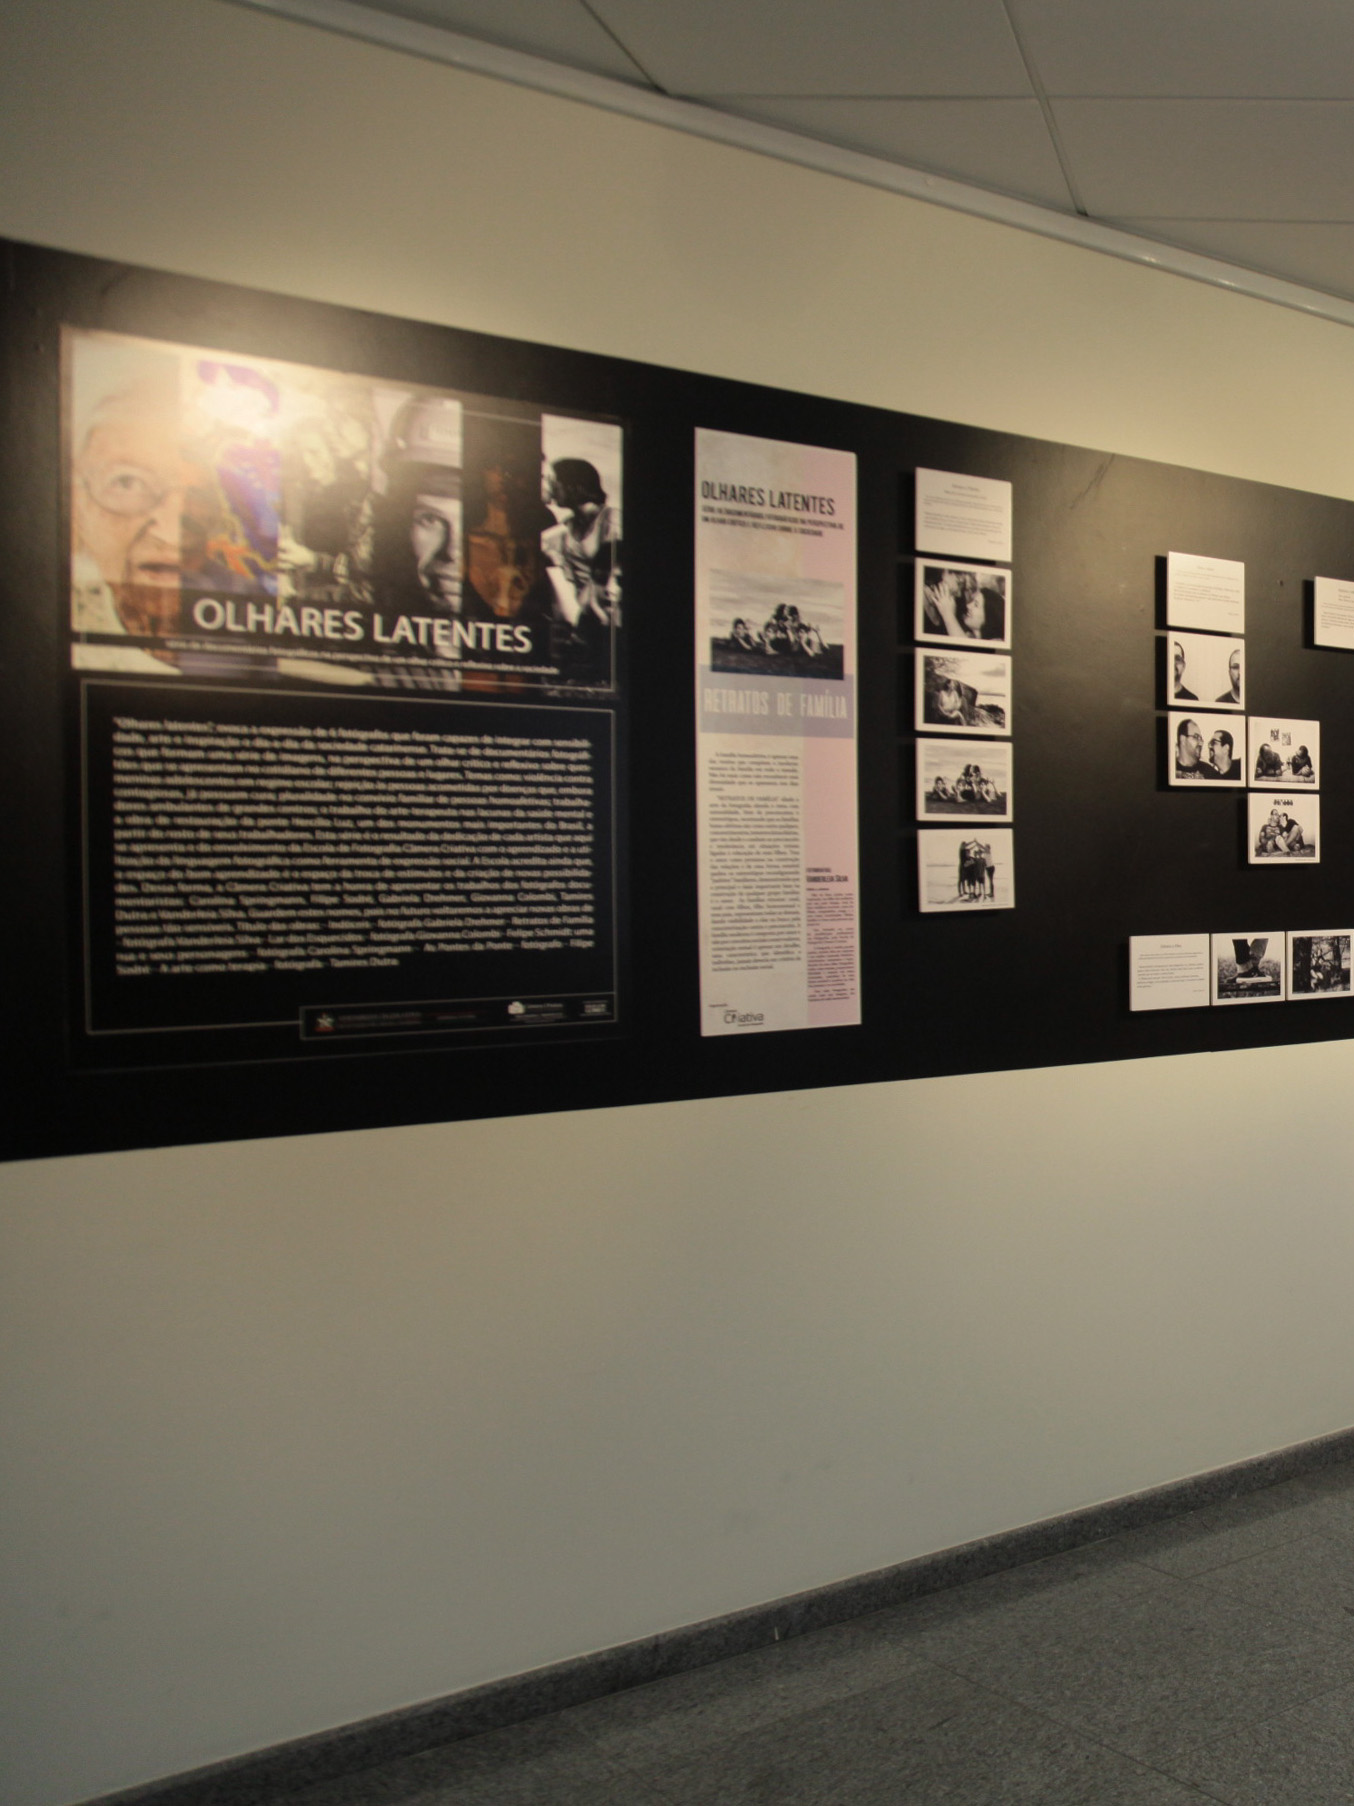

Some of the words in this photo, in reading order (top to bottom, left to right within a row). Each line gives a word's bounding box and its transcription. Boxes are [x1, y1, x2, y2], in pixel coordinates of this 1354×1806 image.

[702, 480, 766, 507] OLHARES
[768, 489, 836, 516] LATENTES
[193, 597, 365, 641] OLHARES
[372, 612, 533, 654] LATENTES
[703, 687, 769, 716] RETRATOS
[776, 692, 793, 717] DE
[800, 688, 848, 719] FAMÍLIA
